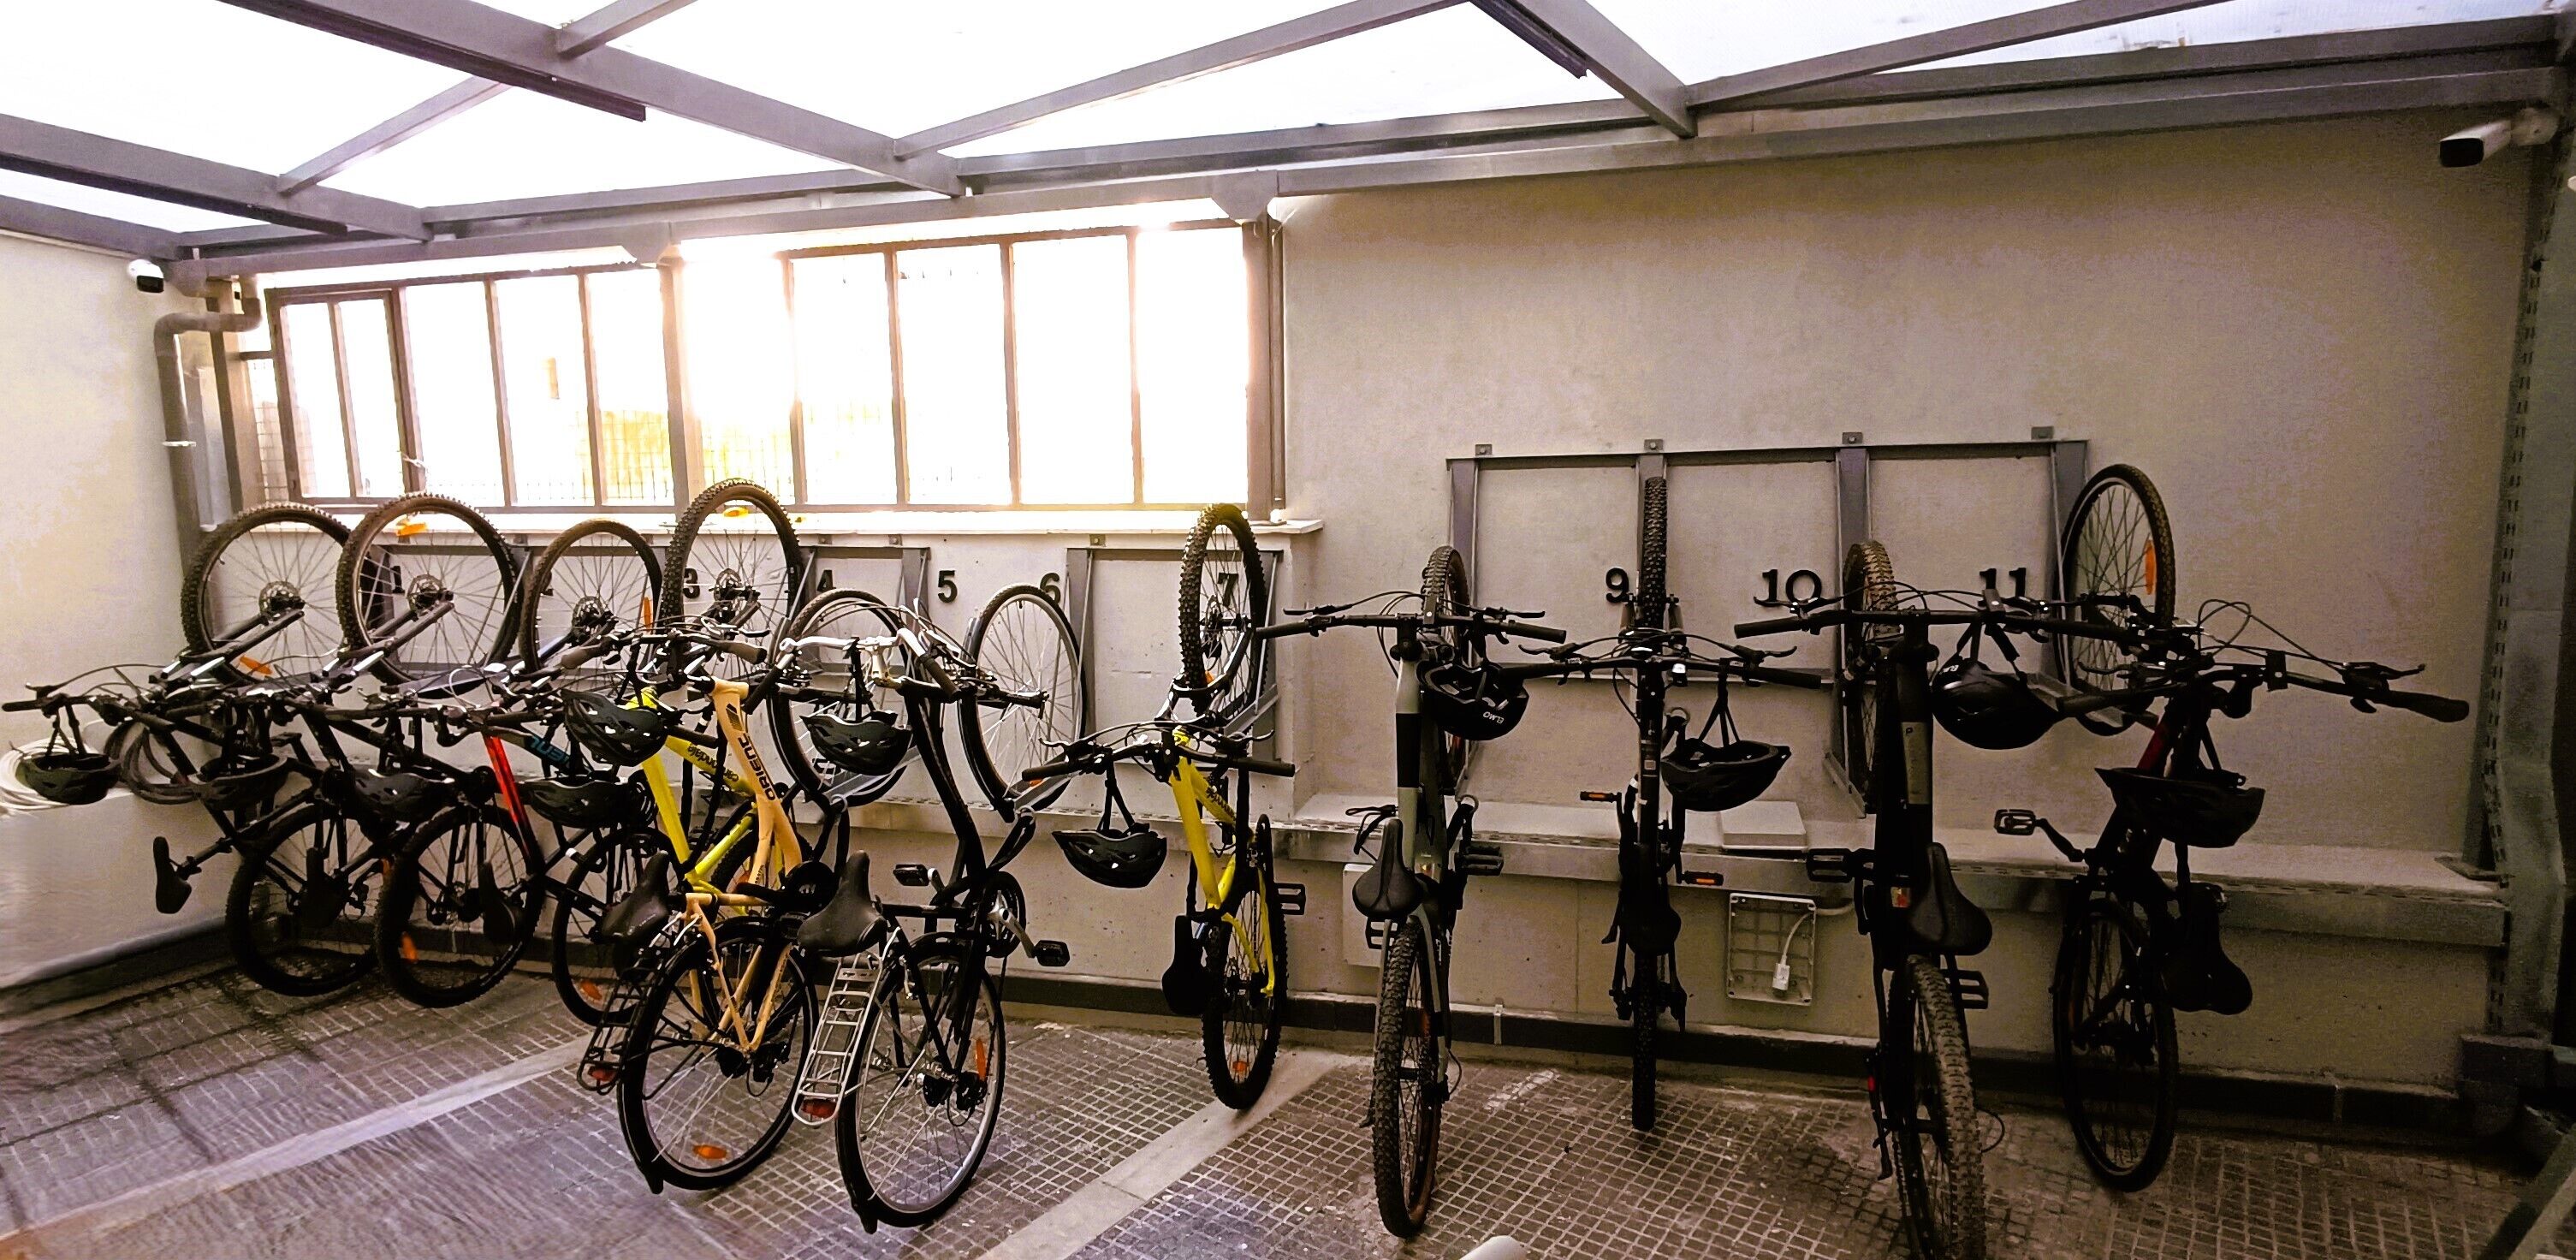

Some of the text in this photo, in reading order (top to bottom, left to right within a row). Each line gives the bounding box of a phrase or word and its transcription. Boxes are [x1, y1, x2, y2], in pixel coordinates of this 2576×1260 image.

[683, 568, 700, 598] 3
[816, 569, 837, 591] 4
[937, 569, 958, 603] 5
[1040, 572, 1060, 603] 6
[1217, 572, 1239, 607] 7
[1605, 567, 1629, 603] 9
[1761, 568, 1822, 603] 10
[1979, 567, 2027, 597] 11
[737, 732, 776, 800] ORIENT
